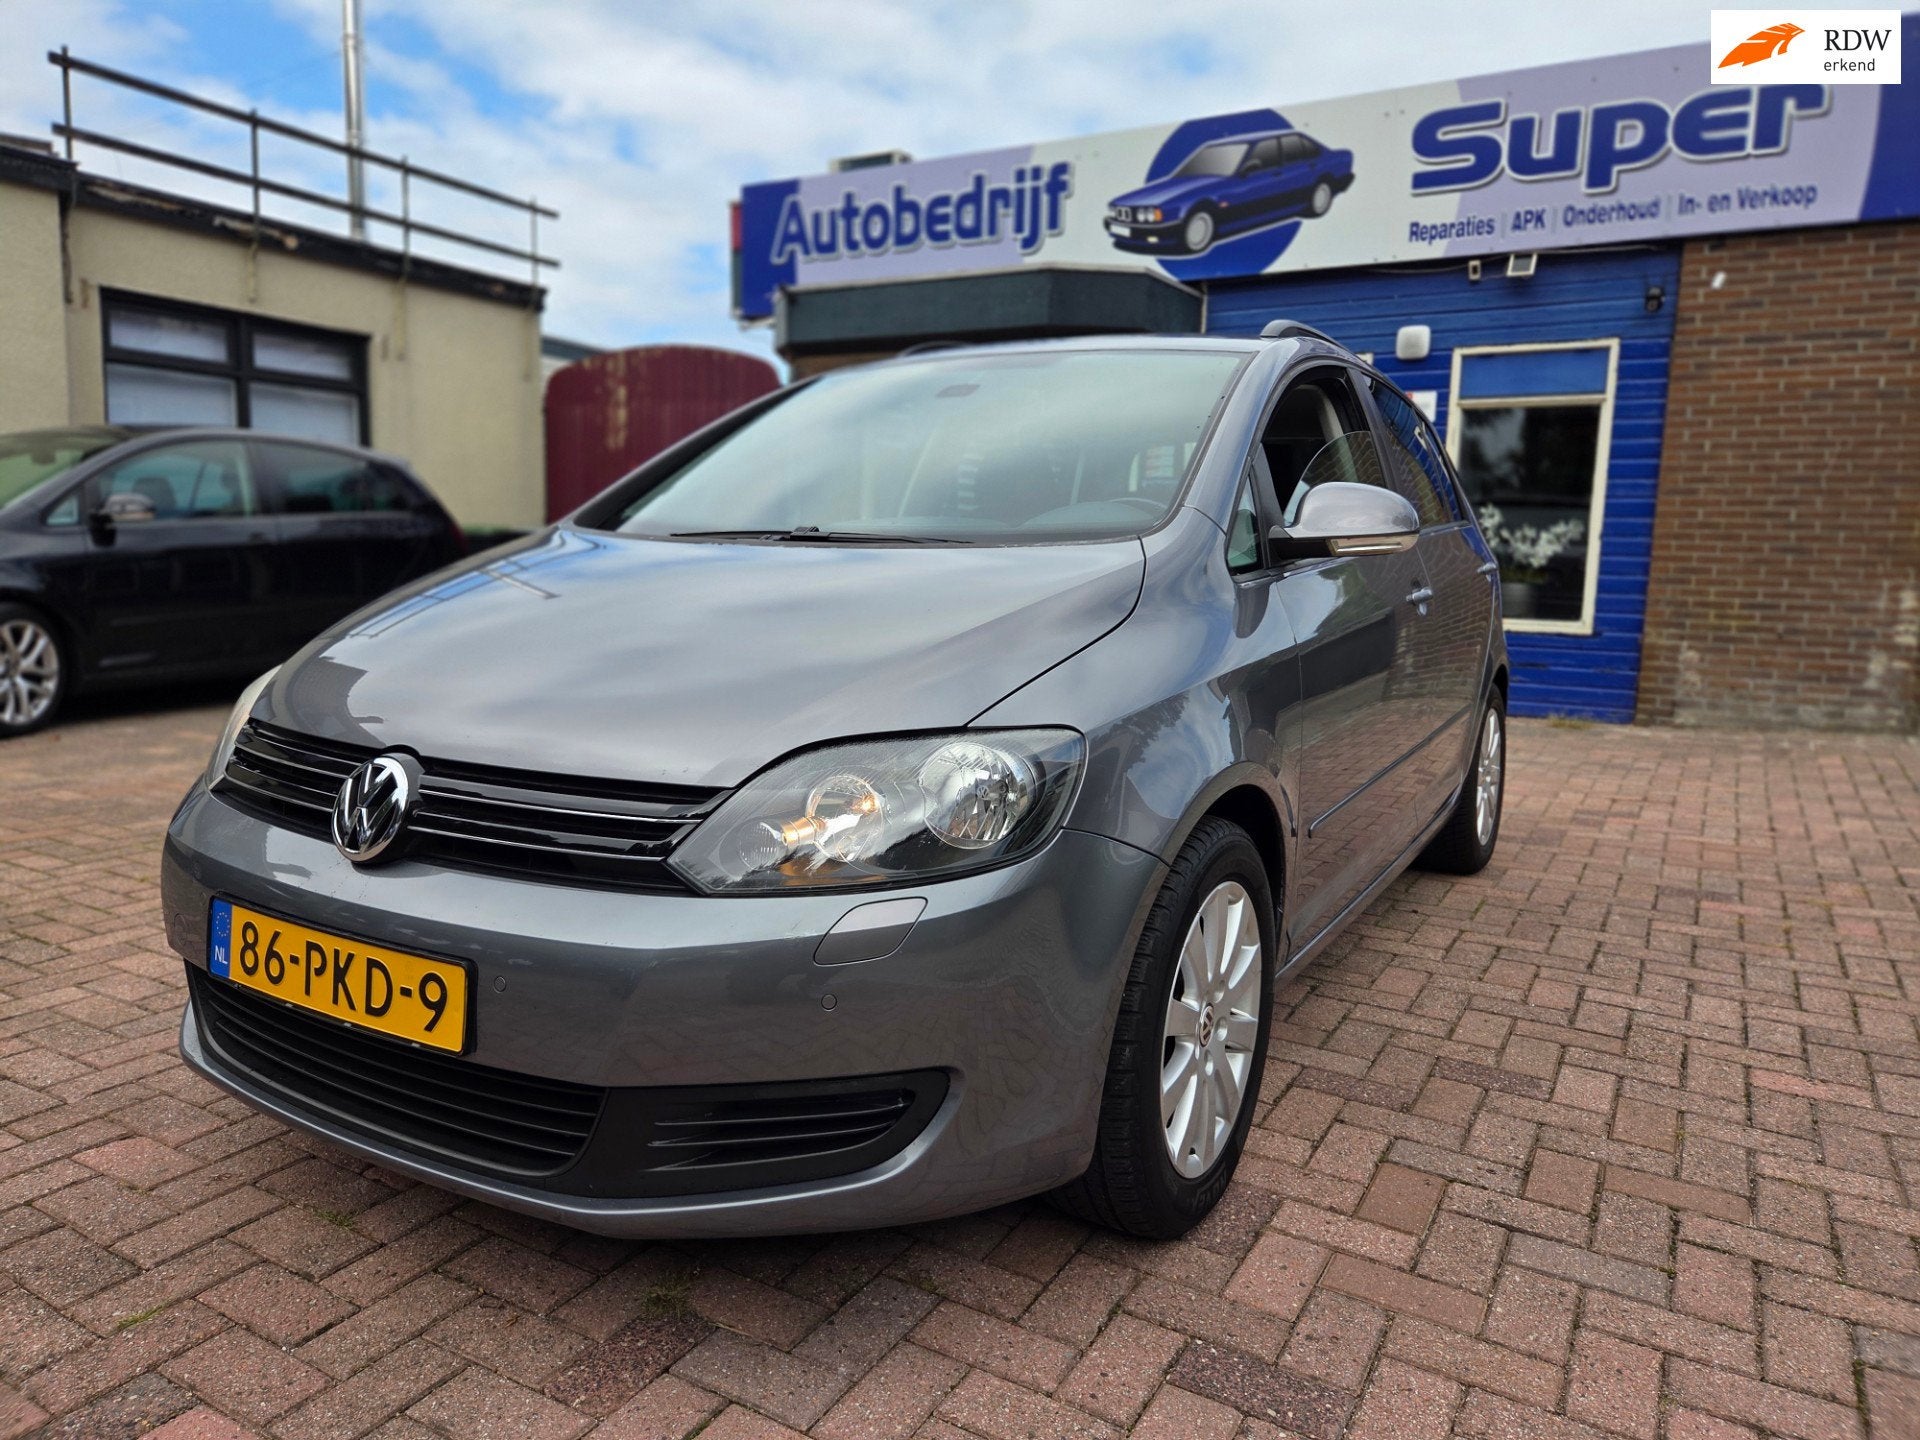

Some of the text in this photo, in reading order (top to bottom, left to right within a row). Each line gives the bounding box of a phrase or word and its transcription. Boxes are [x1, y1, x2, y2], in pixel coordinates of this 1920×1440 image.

[1411, 84, 1830, 196] Super
[770, 161, 1074, 265] Autobedrijf
[1409, 183, 1818, 245] Reparaties APK Onderhoud In- en Verkoop
[213, 944, 229, 965] NL
[239, 920, 448, 1033] 86-PKD-9
